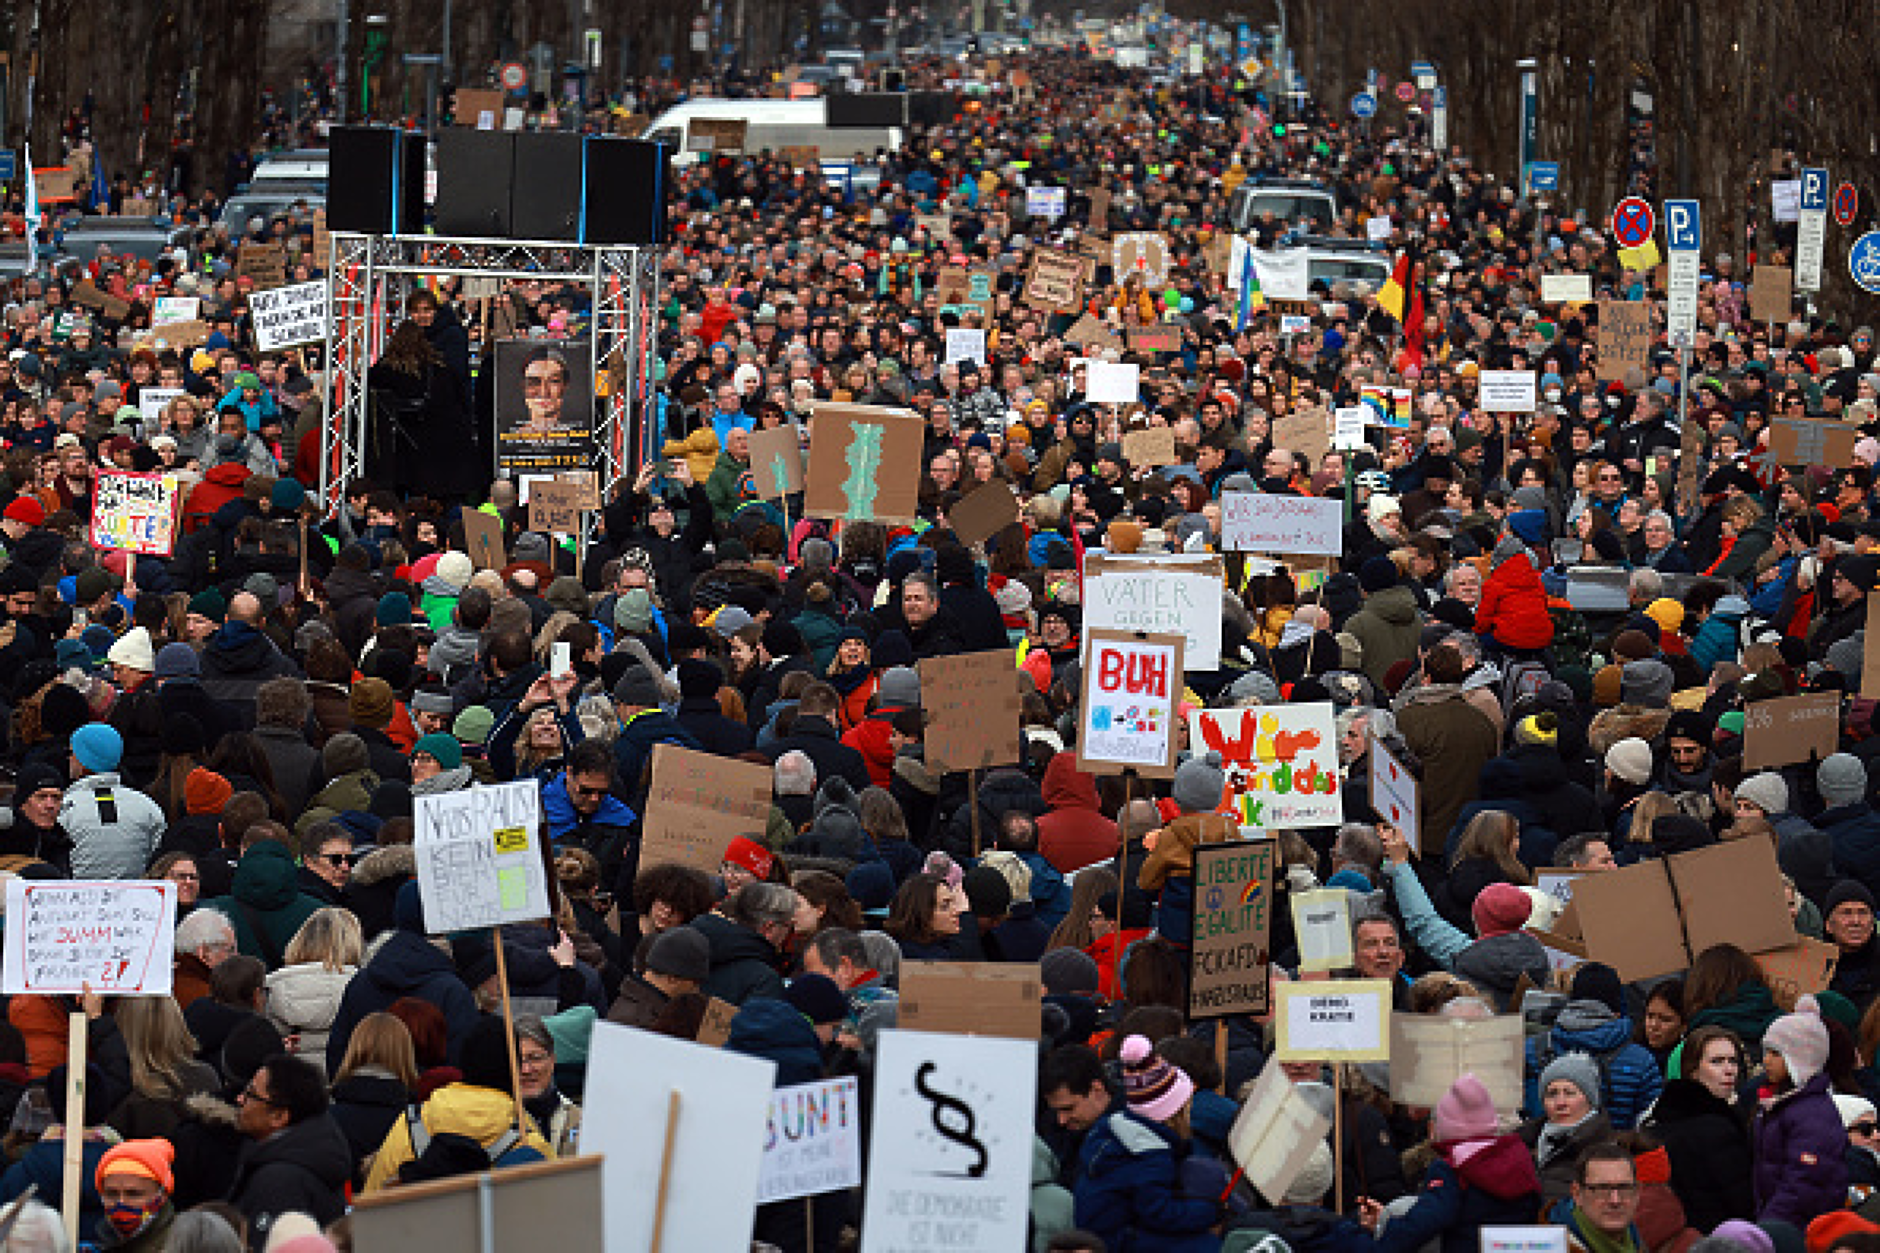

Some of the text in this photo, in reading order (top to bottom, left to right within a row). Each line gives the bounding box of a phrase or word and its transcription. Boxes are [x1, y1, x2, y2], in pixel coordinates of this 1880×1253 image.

[1671, 205, 1690, 244] P
[1101, 579, 1194, 608] VÄTER
[1114, 610, 1182, 627] GEGEN
[1098, 647, 1168, 700] BUH
[430, 839, 492, 867] KEIN
[54, 926, 112, 944] DUMM
